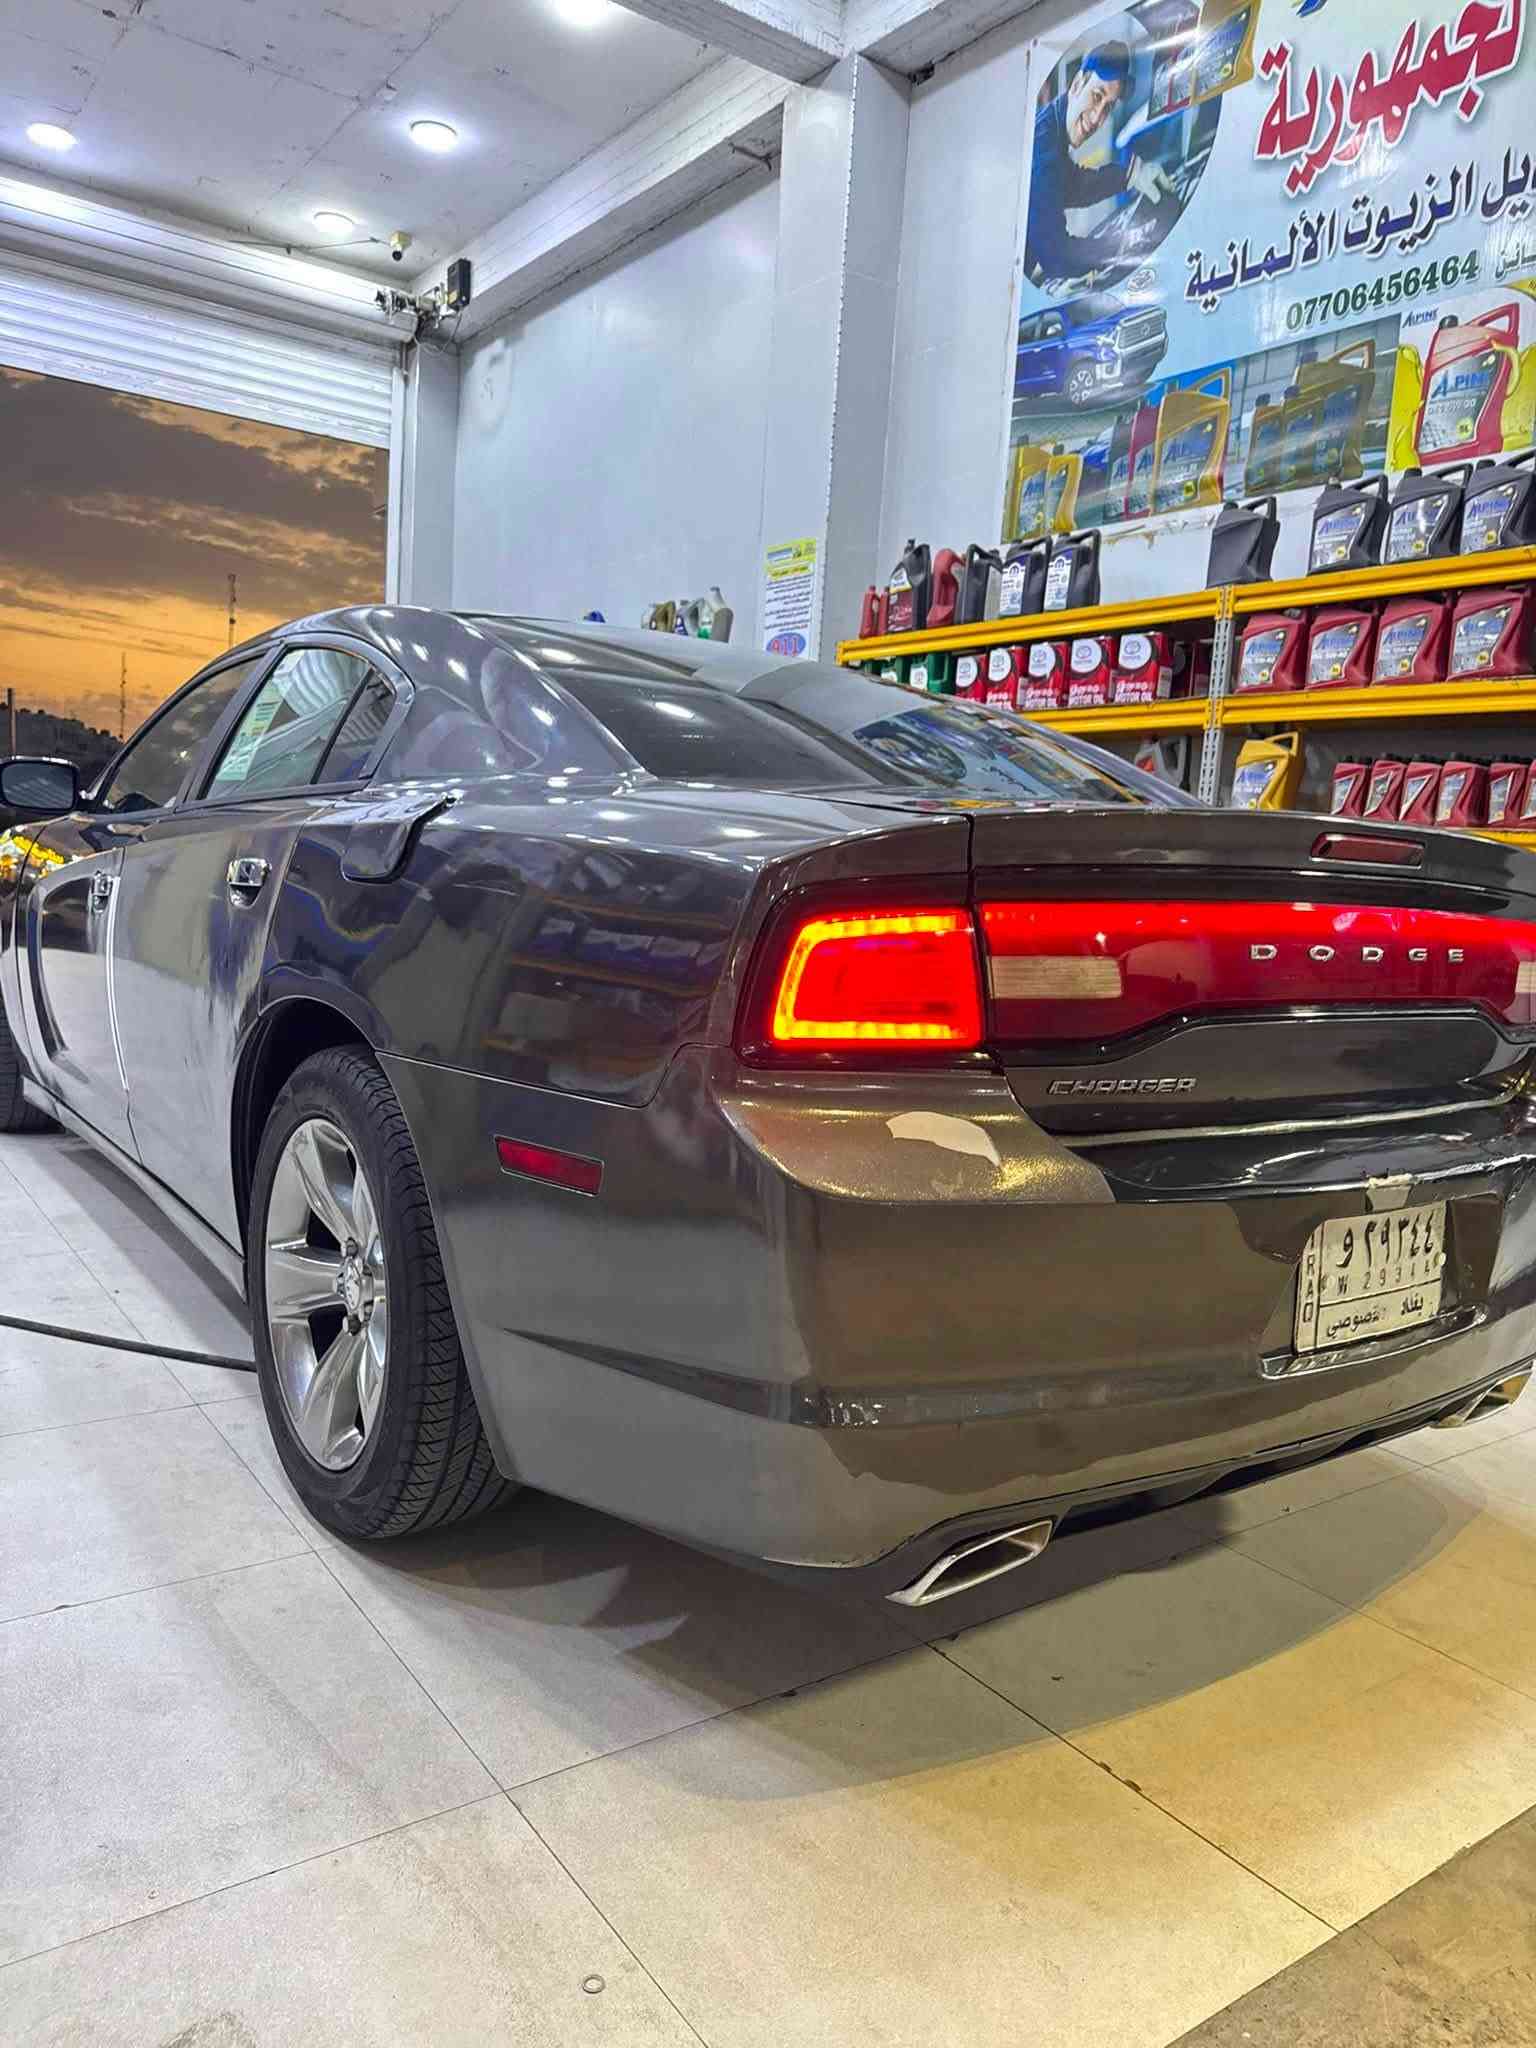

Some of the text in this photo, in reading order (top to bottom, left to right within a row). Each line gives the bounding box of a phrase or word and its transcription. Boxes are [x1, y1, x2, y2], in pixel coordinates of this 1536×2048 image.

[1346, 161, 1474, 254] الزيوت
[1186, 209, 1336, 307] الألمانية
[1287, 249, 1479, 330] 07706456464
[1250, 944, 1464, 962] DODGE
[1048, 1077, 1197, 1096] CHARGER
